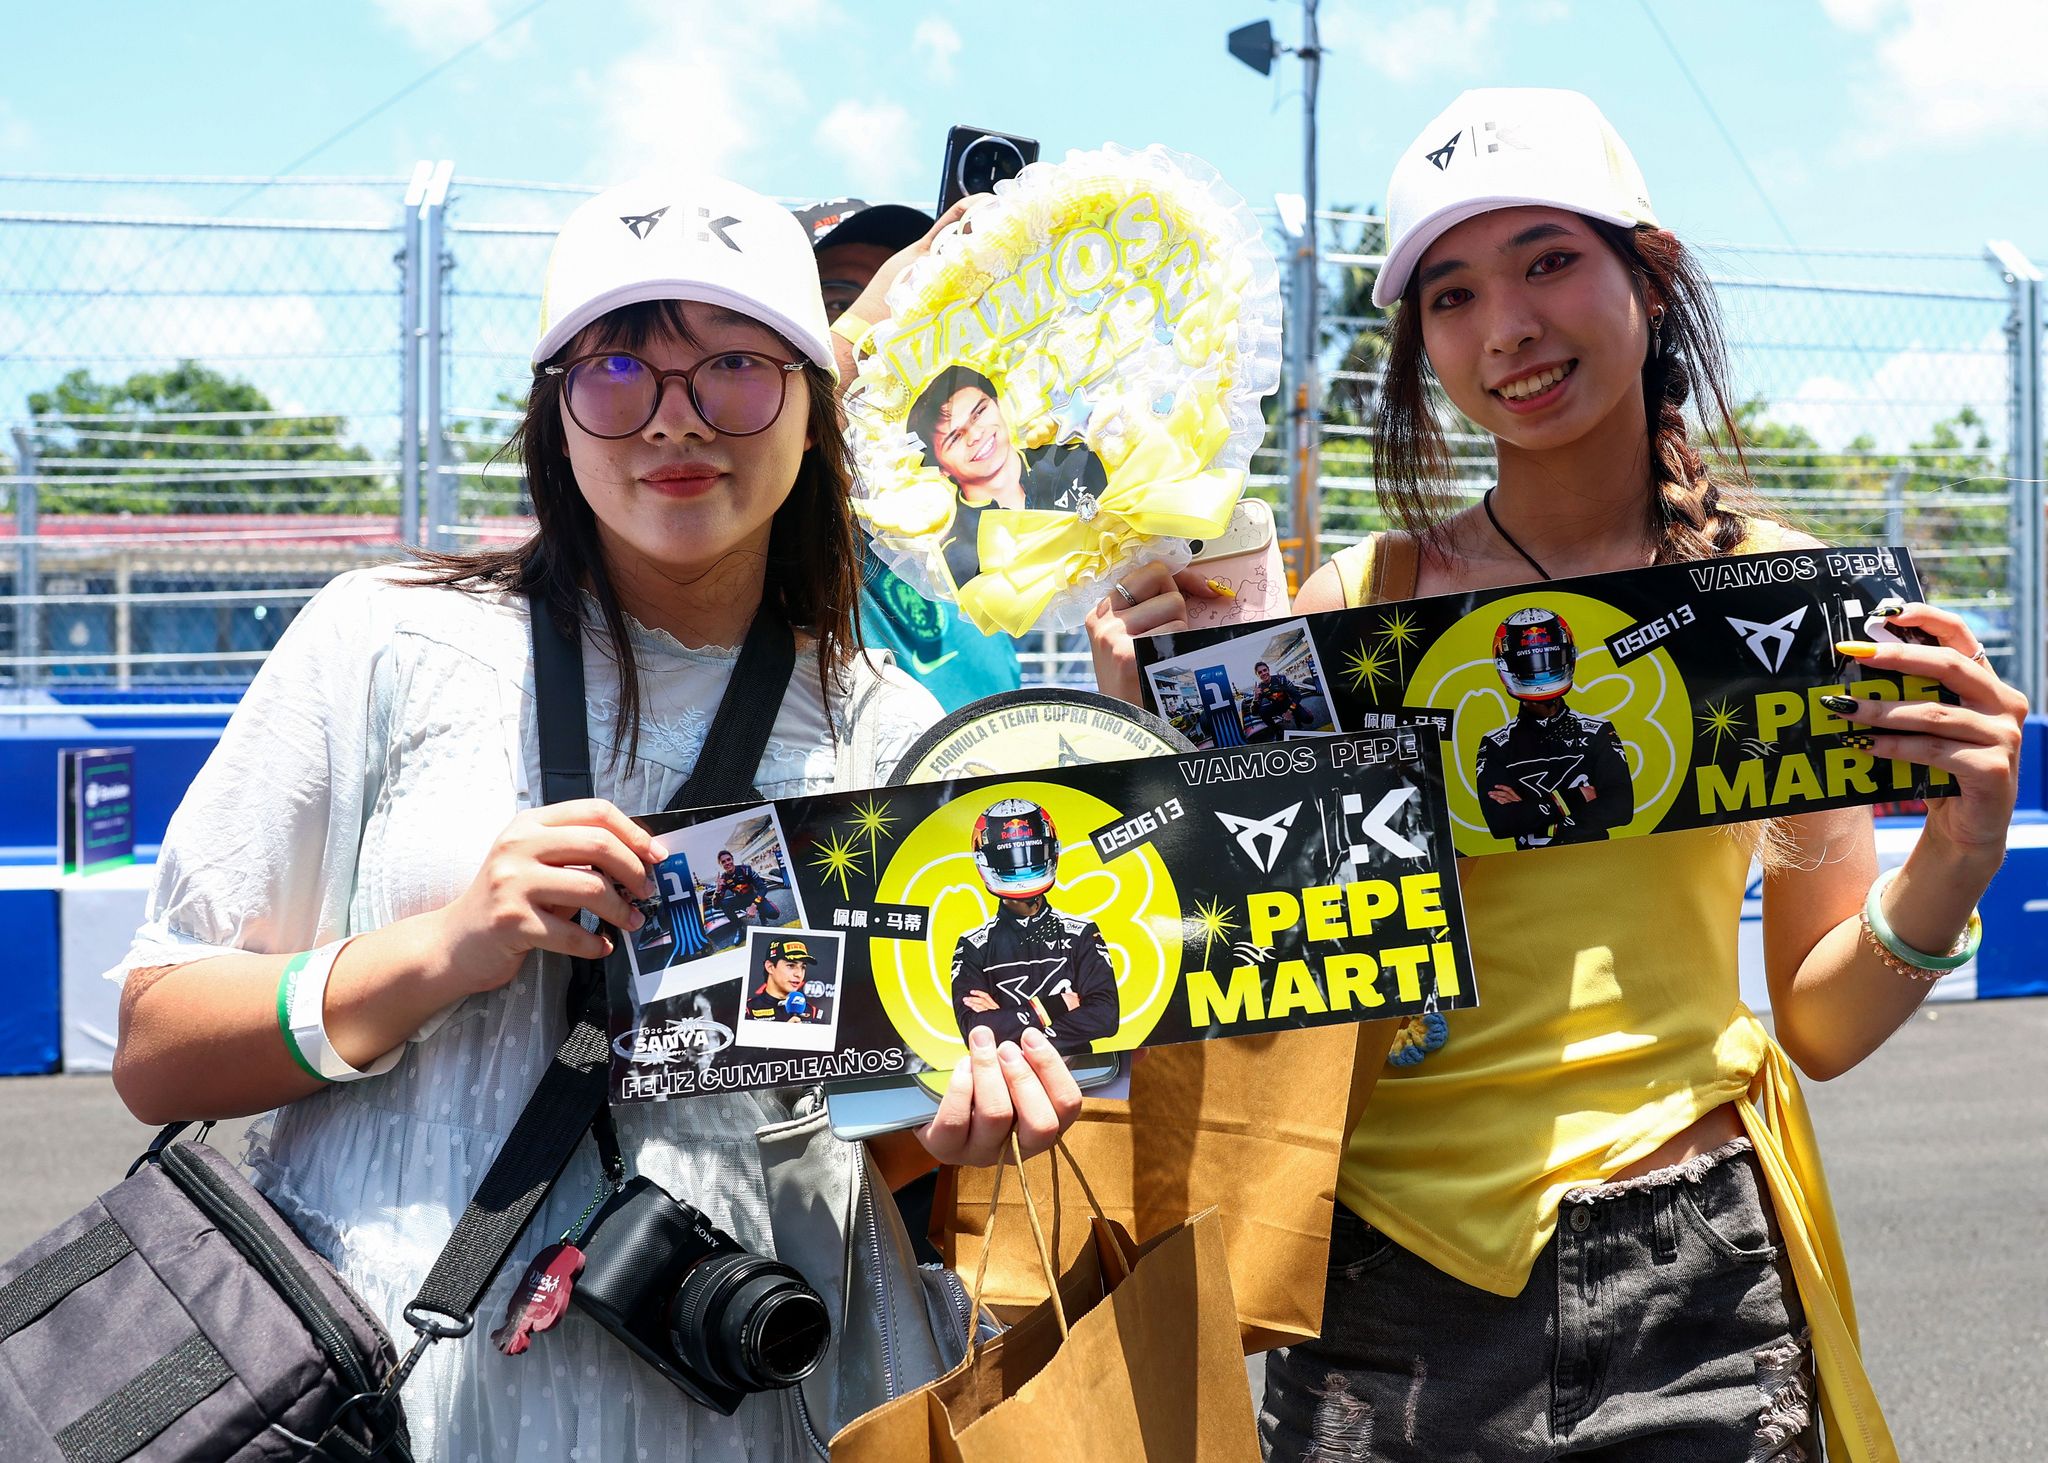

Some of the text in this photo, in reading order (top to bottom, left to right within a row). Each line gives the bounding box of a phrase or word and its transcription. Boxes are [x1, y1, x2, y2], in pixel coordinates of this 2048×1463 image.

[885, 192, 1168, 393] VAMOS
[1688, 553, 1900, 592] VAMOS PEPE
[1612, 603, 1696, 659] 050613
[1516, 649, 1531, 657] GIVES
[1204, 682, 1231, 711] 1
[930, 725, 989, 774] FORMULA
[987, 718, 999, 735] E
[999, 707, 1039, 730] TEAM
[1043, 706, 1088, 725] CUPRA
[1091, 712, 1123, 735] KIRO
[1123, 726, 1151, 751] HAS
[1178, 735, 1419, 786] VAMOS PEPE
[1001, 828, 1033, 839] Red Bull
[1097, 797, 1185, 855] 050613
[997, 843, 1012, 851] GIVES
[663, 872, 691, 903] 1
[833, 908, 922, 932] 佩佩·马蒂
[1246, 872, 1447, 949] PEPE
[1185, 926, 1460, 1028] MARTÍ
[635, 1031, 709, 1054] SANYA
[622, 1048, 904, 1099] FELIZ CUMPLEAÑOS
[693, 1223, 720, 1248] SONY
